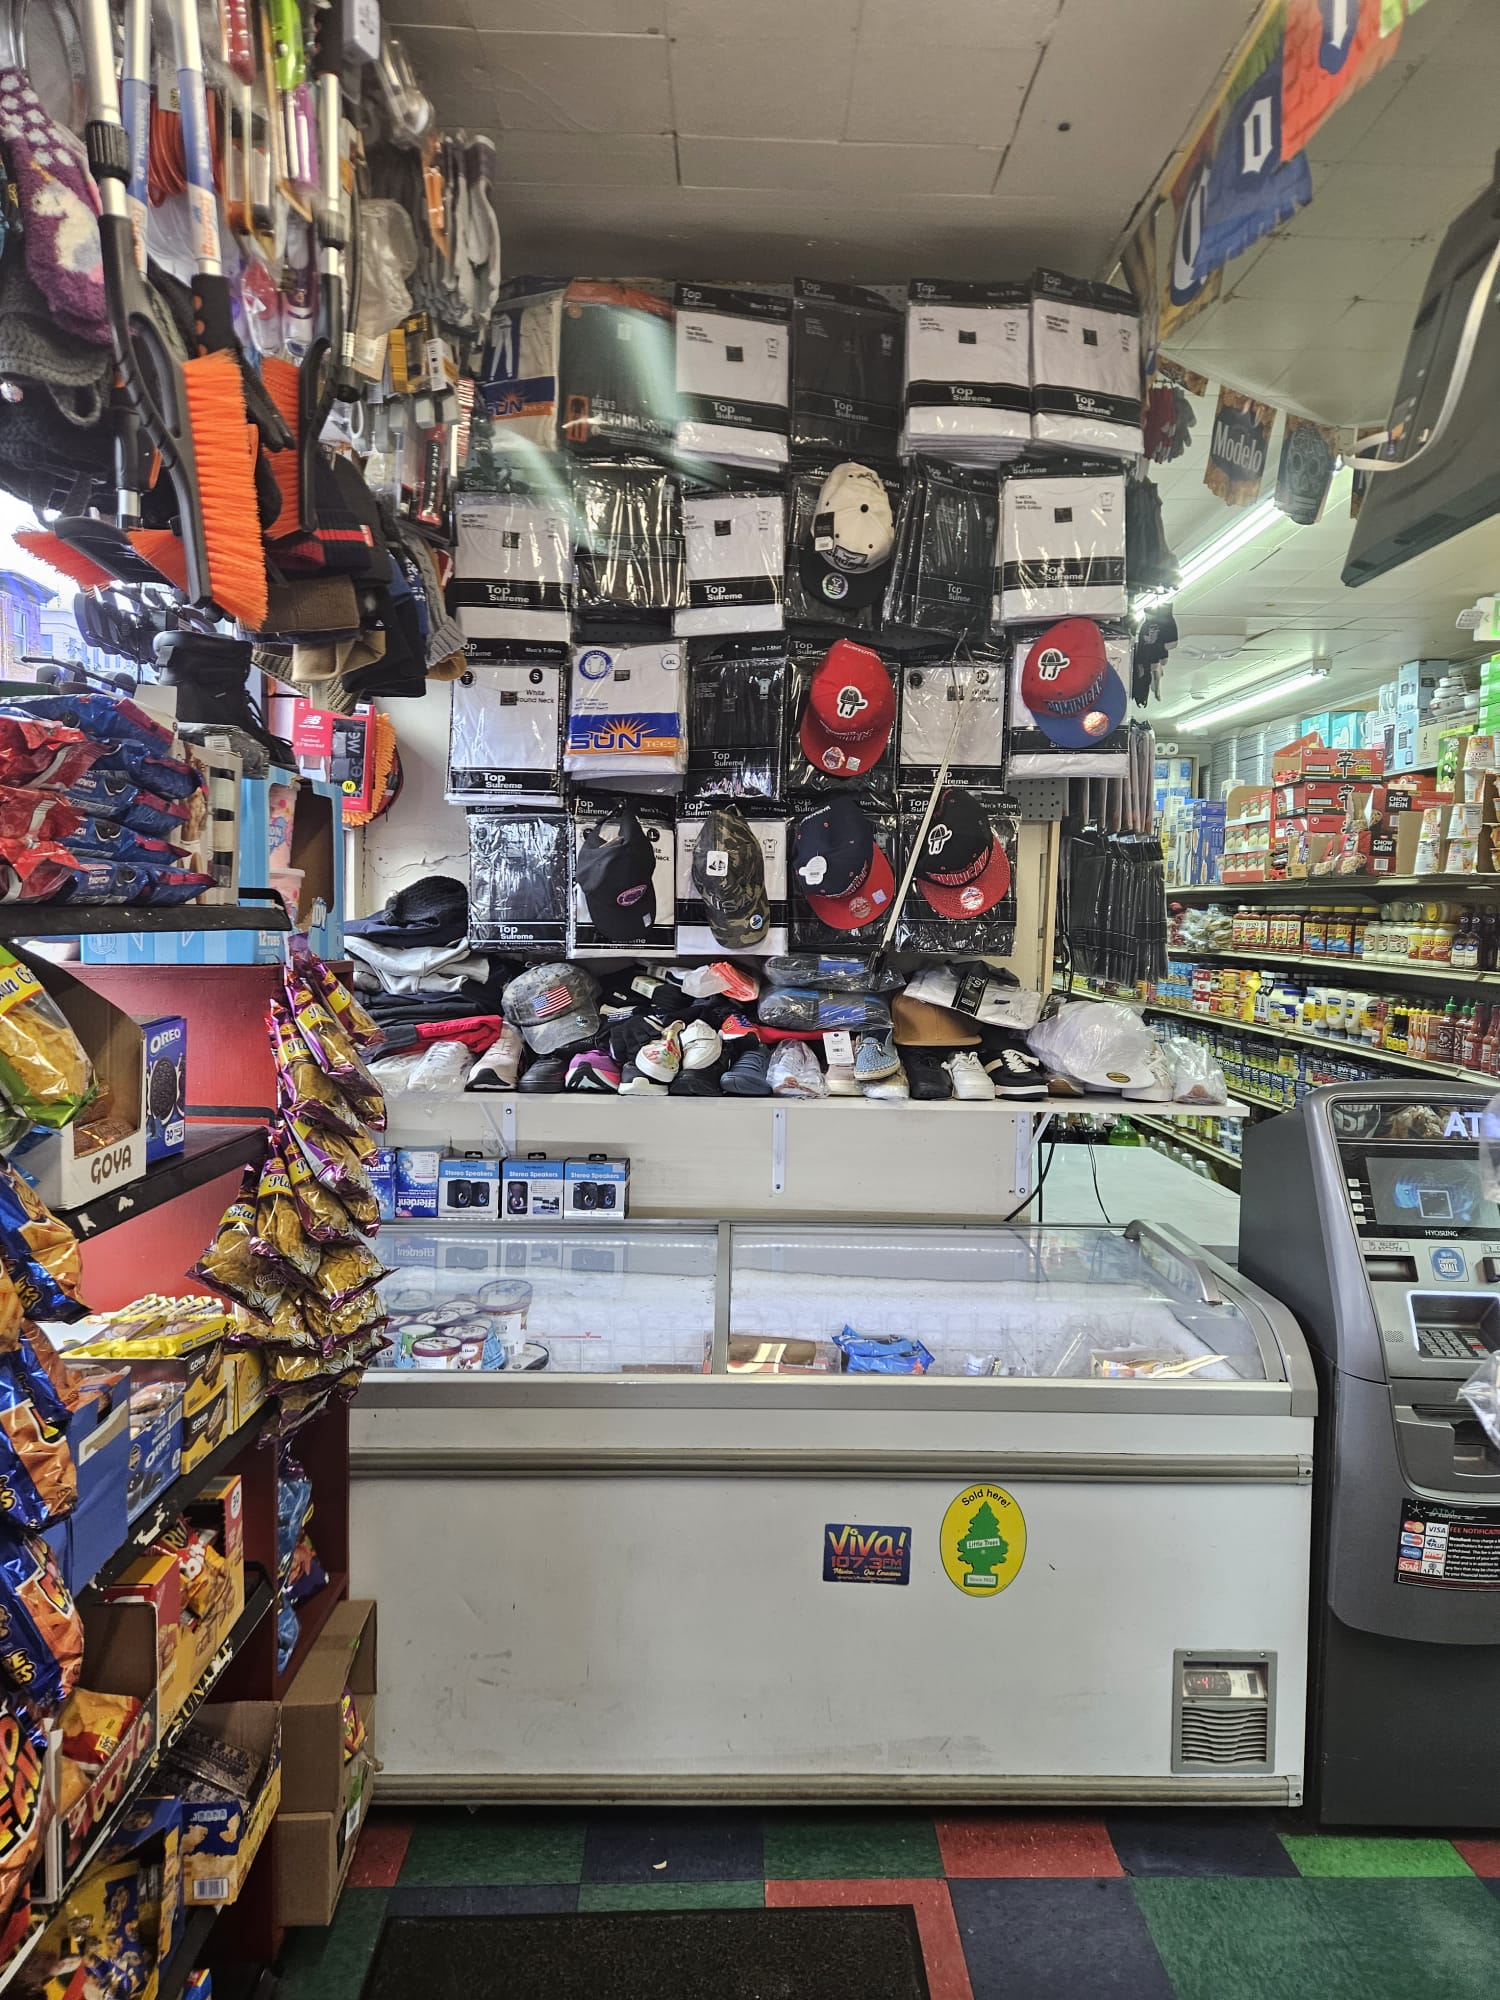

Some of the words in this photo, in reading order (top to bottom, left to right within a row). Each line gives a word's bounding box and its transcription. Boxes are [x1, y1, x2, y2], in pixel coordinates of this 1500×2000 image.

[800, 280, 820, 293] Top
[682, 288, 702, 300] Top
[949, 386, 974, 400] Top
[833, 399, 853, 414] Top
[1074, 394, 1096, 406] Top
[712, 401, 735, 415] Top
[1213, 420, 1262, 472] Modelo
[1044, 564, 1065, 576] Top
[486, 584, 510, 597] Top
[704, 585, 726, 598] Top
[489, 594, 530, 603] Supreme
[707, 593, 742, 602] Supreme
[464, 642, 477, 652] op
[794, 641, 813, 652] Top
[570, 732, 642, 750] SUN
[712, 752, 730, 764] Top
[1336, 750, 1357, 779] 辛
[482, 773, 506, 785] Top
[931, 770, 952, 780] Tp
[574, 799, 594, 812] Top
[909, 799, 928, 810] Top
[499, 925, 518, 938] Top
[150, 1028, 182, 1054] OREO
[90, 1145, 132, 1184] GOYA
[362, 1163, 390, 1172] erdent
[398, 1197, 436, 1209] Efferdent
[1440, 1263, 1460, 1272] SMALL
[145, 1433, 171, 1468] OREO
[961, 1489, 984, 1506] Sold
[986, 1488, 1011, 1508] here!
[828, 1525, 907, 1557] Viva!
[832, 1556, 883, 1569] 107.3
